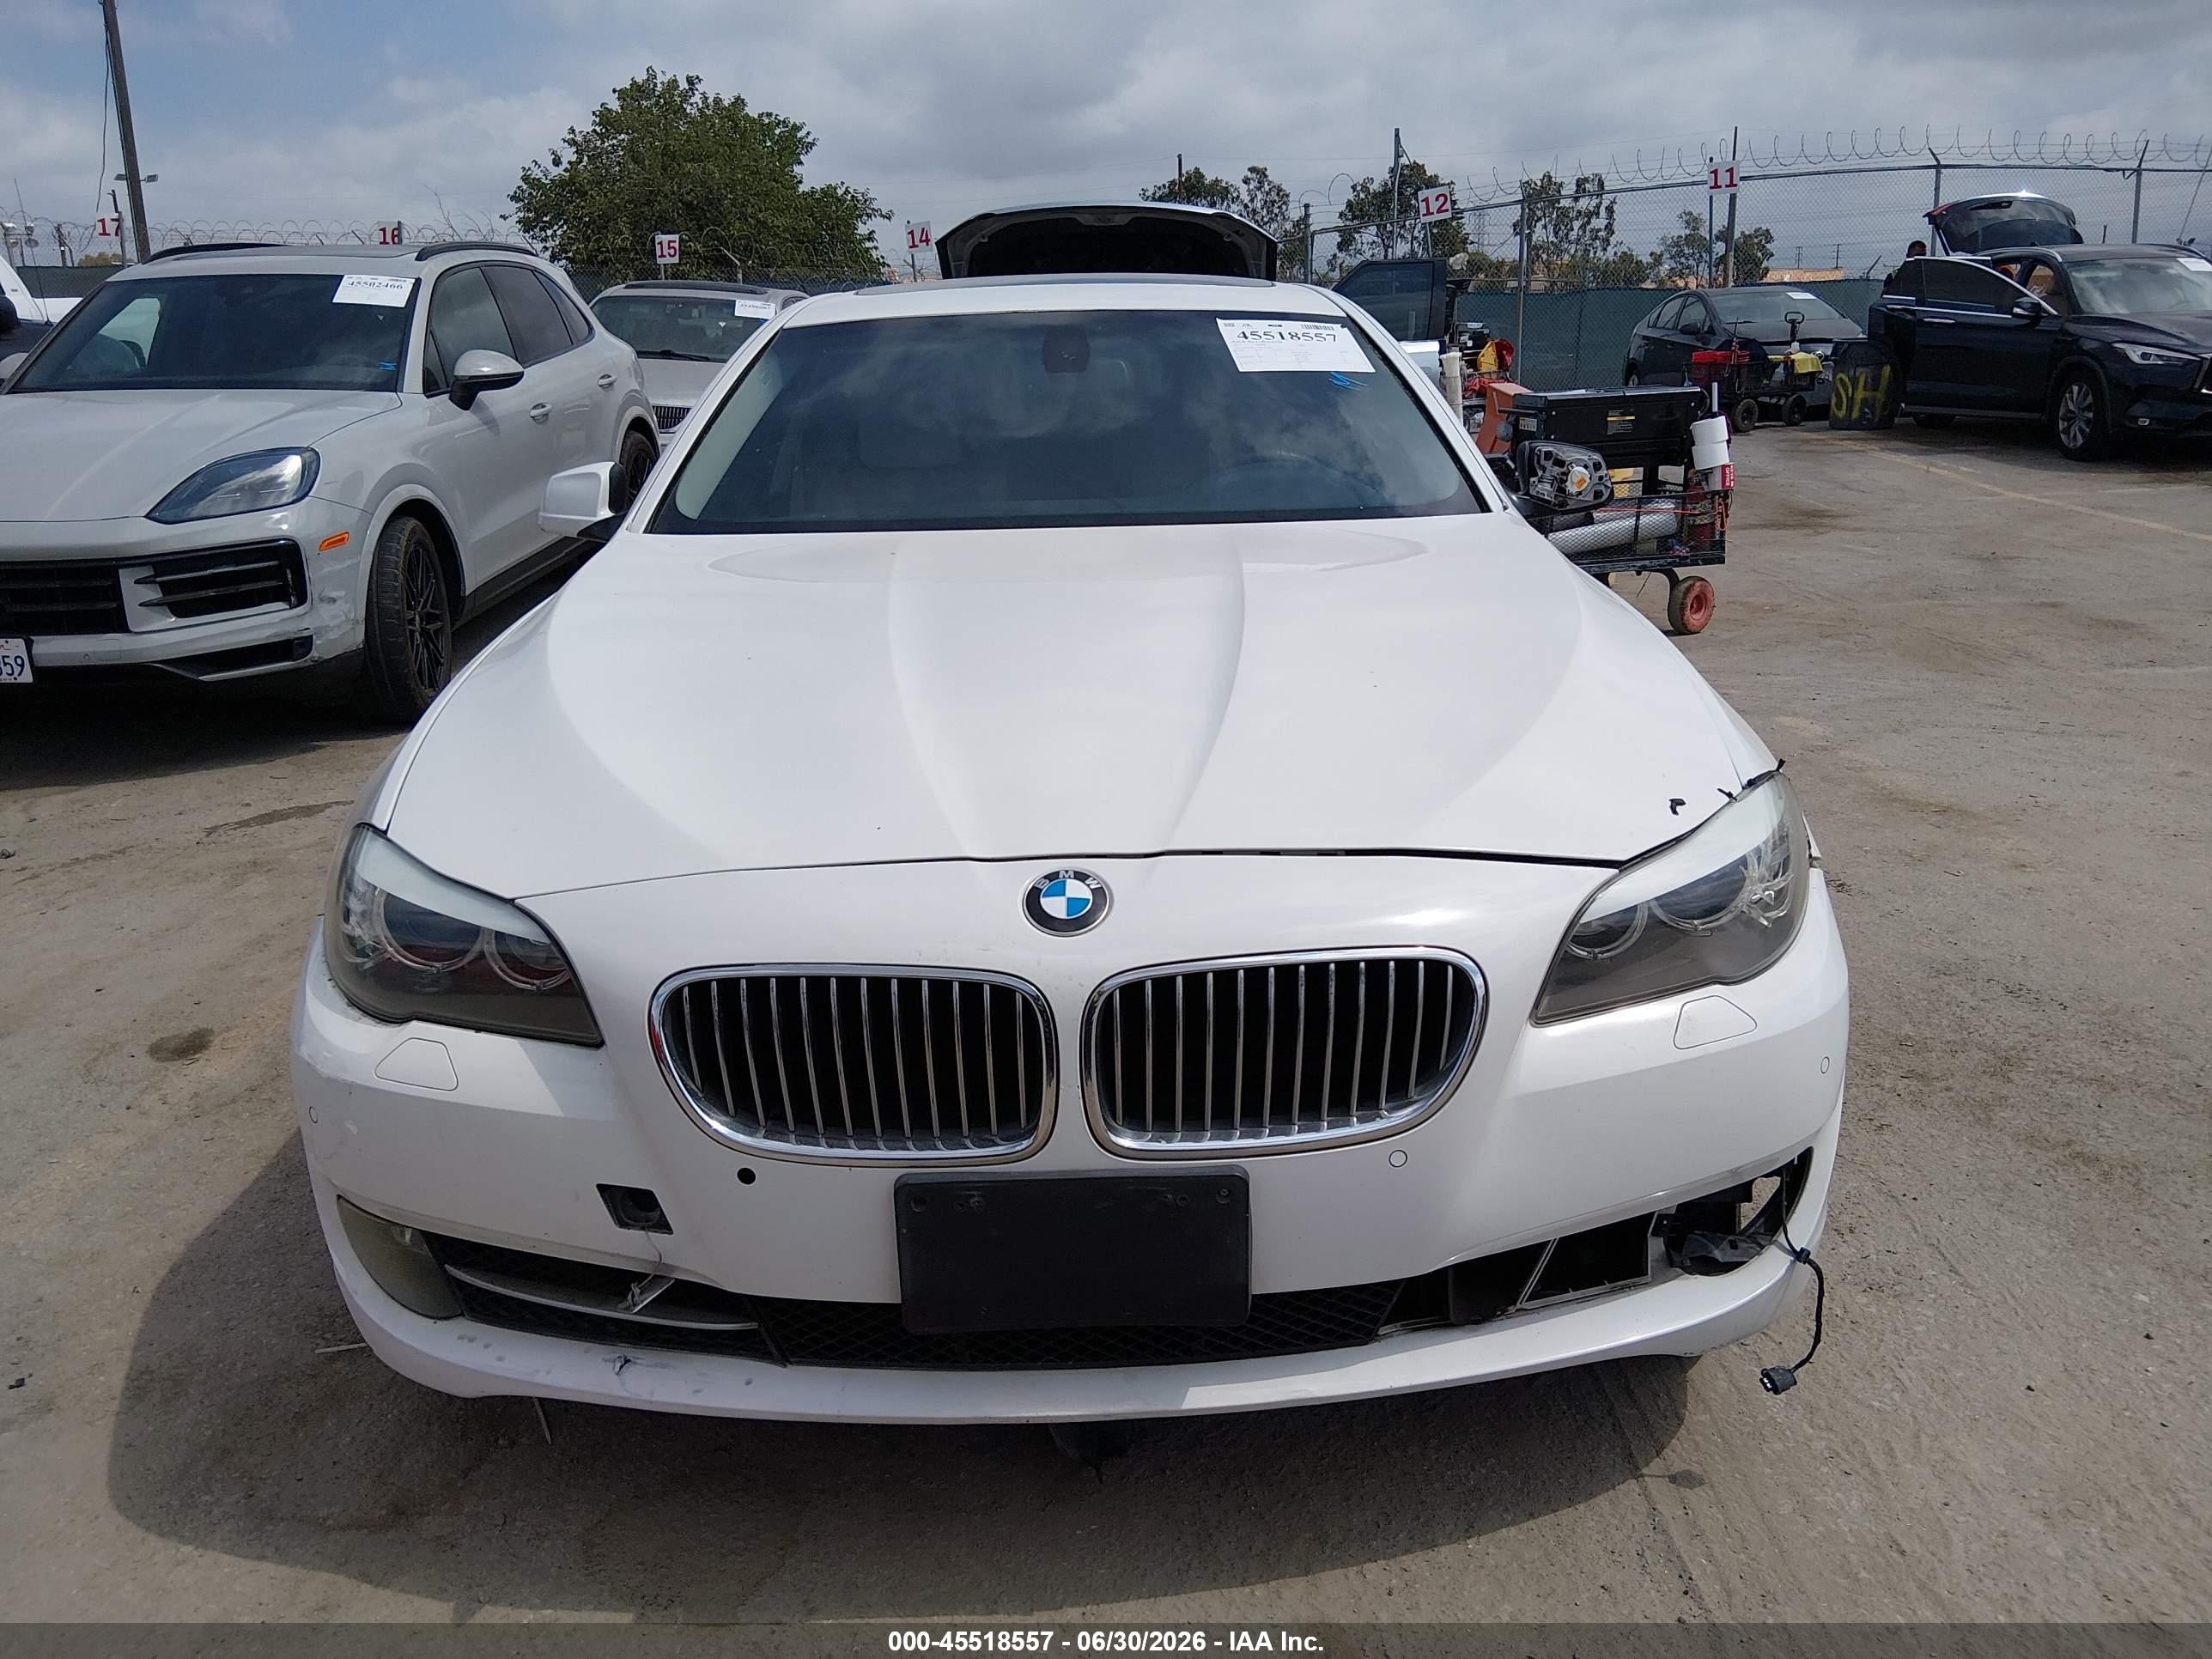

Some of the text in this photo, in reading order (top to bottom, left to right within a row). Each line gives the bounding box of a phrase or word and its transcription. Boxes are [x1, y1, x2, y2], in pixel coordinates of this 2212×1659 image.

[1710, 167, 1738, 189] 11
[1420, 193, 1449, 216] 12
[97, 218, 124, 237] 17
[379, 227, 401, 245] 16
[908, 228, 930, 248] 14
[657, 240, 678, 258] 15
[1237, 331, 1337, 343] 45518557
[0, 655, 25, 677] 59
[1034, 870, 1101, 889] BMW
